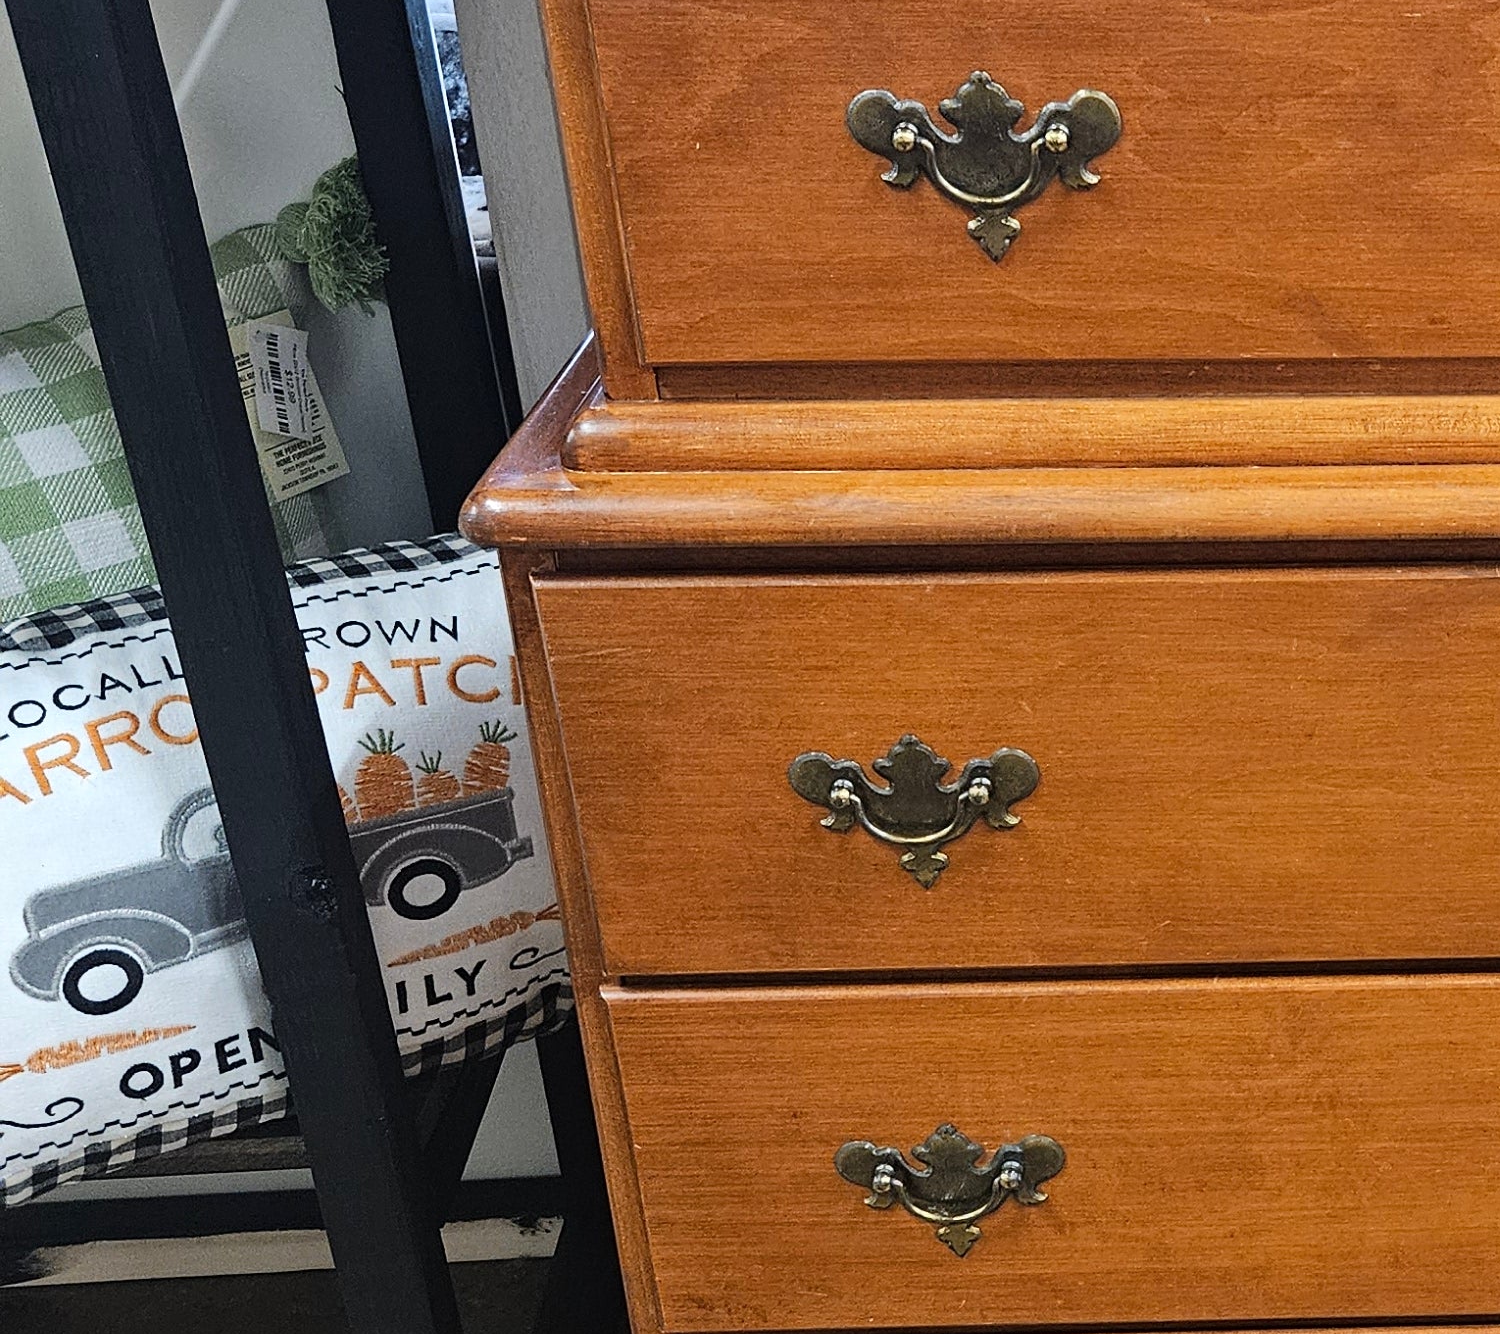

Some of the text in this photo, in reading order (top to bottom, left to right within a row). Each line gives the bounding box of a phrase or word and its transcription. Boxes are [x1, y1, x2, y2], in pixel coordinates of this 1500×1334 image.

[0, 616, 459, 741] OCALL ROWN
[0, 655, 522, 805] RRO ATC
[119, 959, 487, 1101] OPEN ILY
